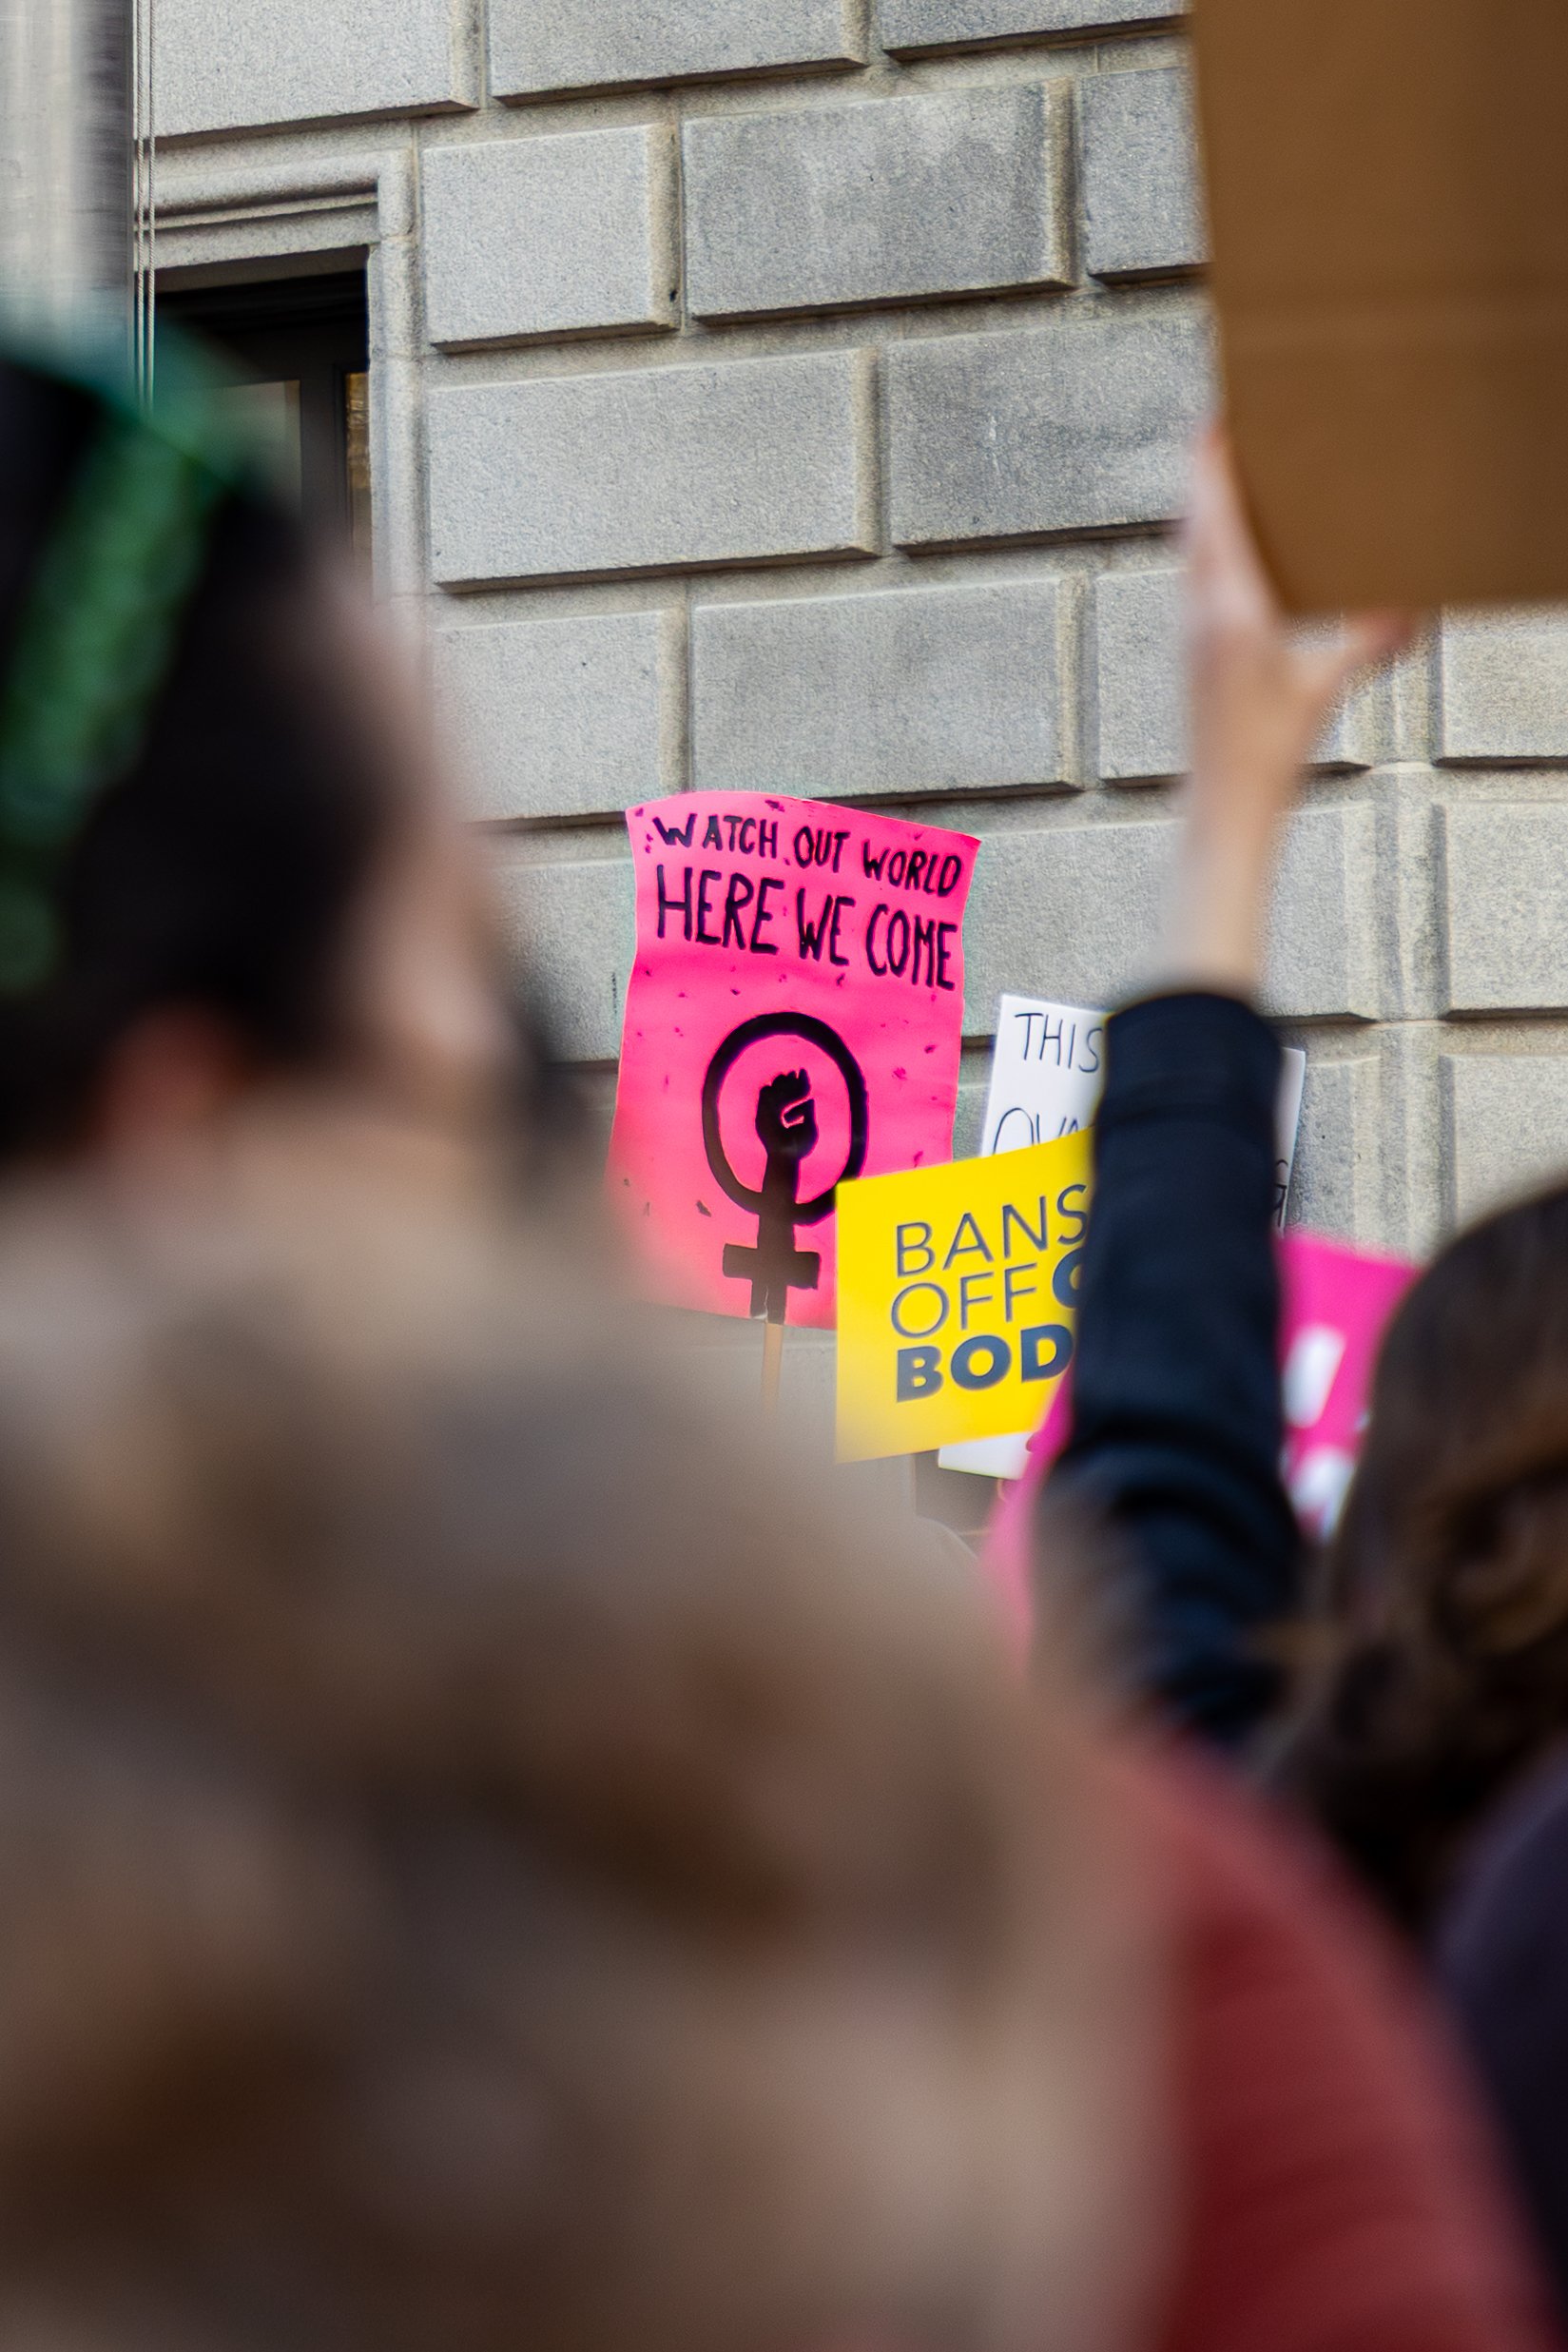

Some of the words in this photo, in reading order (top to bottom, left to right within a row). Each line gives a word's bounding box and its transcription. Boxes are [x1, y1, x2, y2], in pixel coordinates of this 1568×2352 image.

[652, 813, 779, 859] WATCH
[793, 826, 851, 873] OUT
[861, 838, 962, 898] WORLD
[655, 864, 785, 956] HERE
[796, 887, 856, 967] WE
[864, 903, 958, 991] COME
[1014, 1012, 1103, 1074] THIS
[896, 1183, 1089, 1279] BANS
[890, 1261, 1038, 1340] OFF
